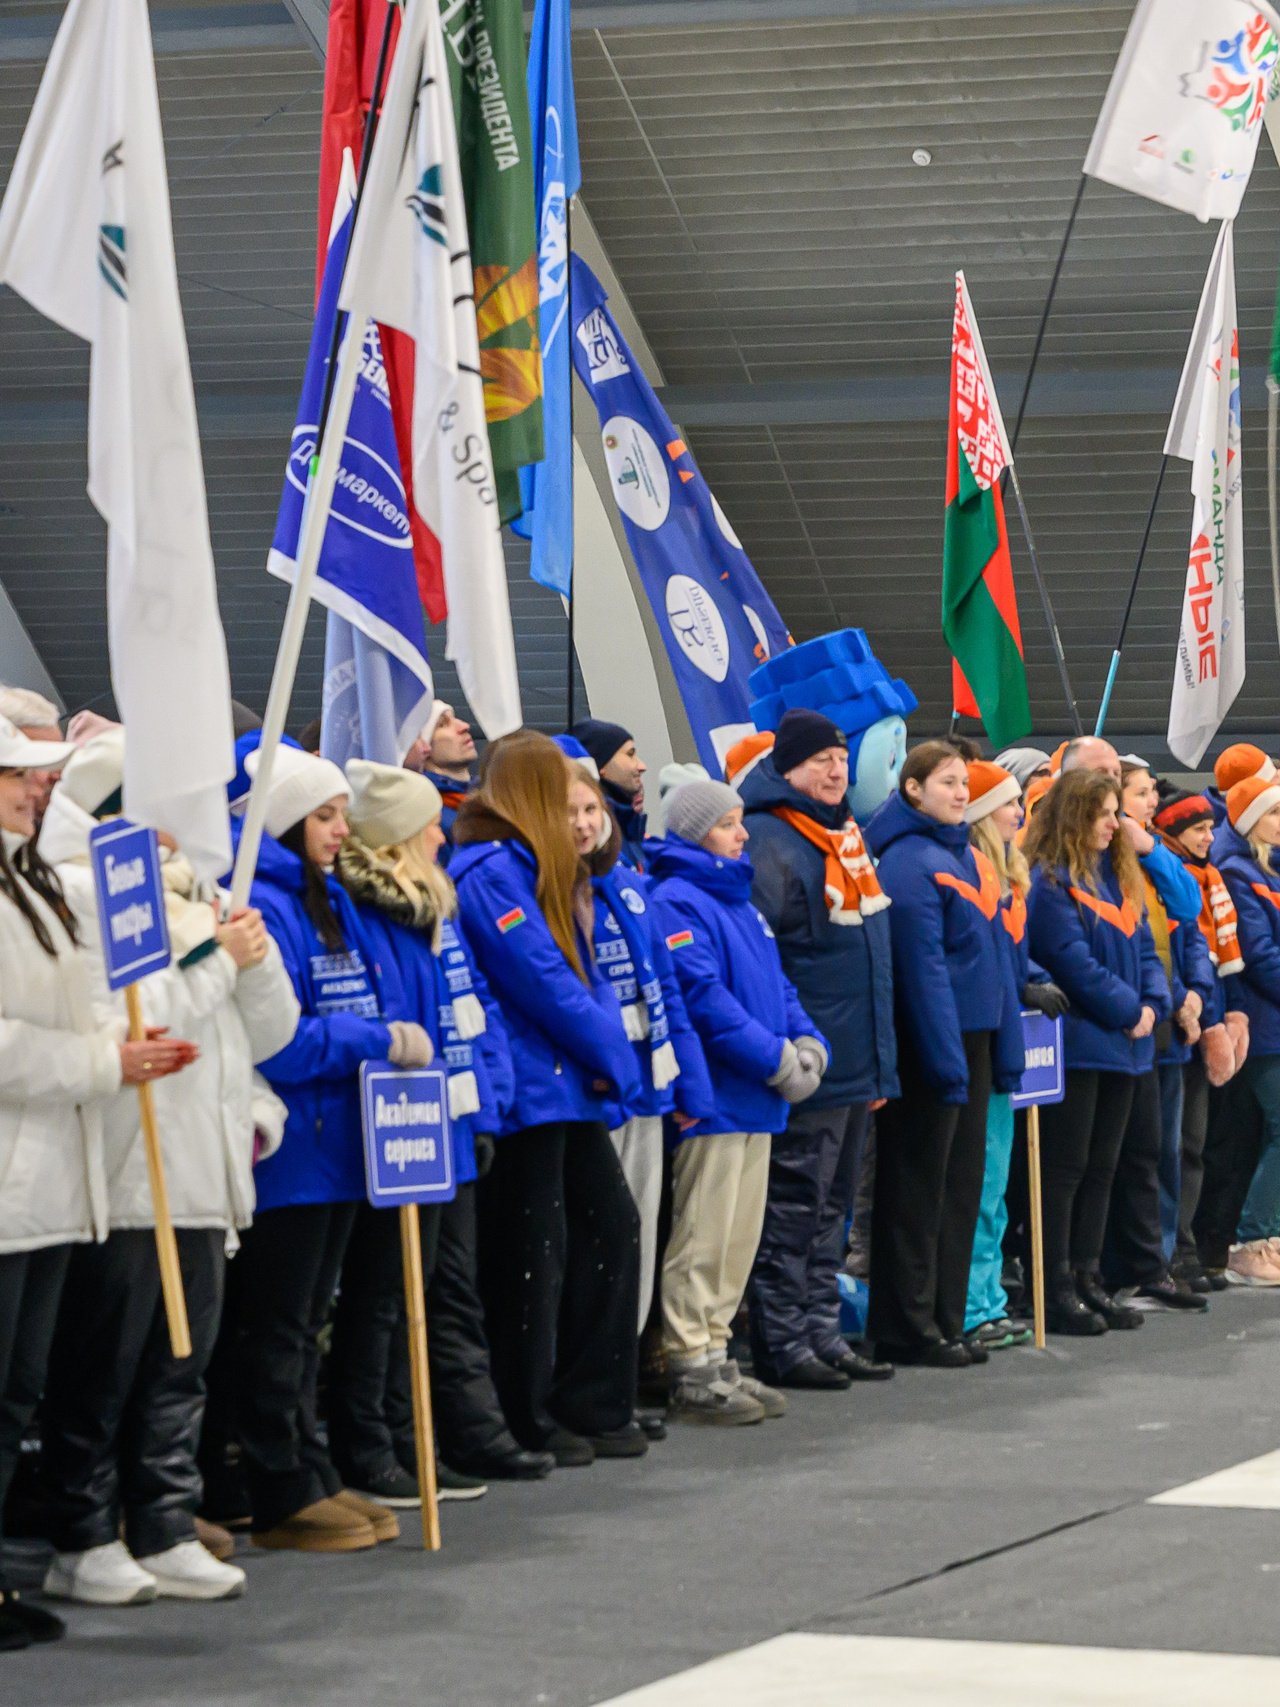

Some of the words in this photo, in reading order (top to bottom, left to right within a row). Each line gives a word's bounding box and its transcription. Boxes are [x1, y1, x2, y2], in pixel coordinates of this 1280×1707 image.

[475, 30, 520, 172] ПРЕЗИДЕНТА
[292, 438, 411, 536] Дмаркет
[1188, 532, 1218, 684] НЫЕ
[375, 1091, 441, 1129] Академия
[384, 1137, 437, 1173] сервиса
